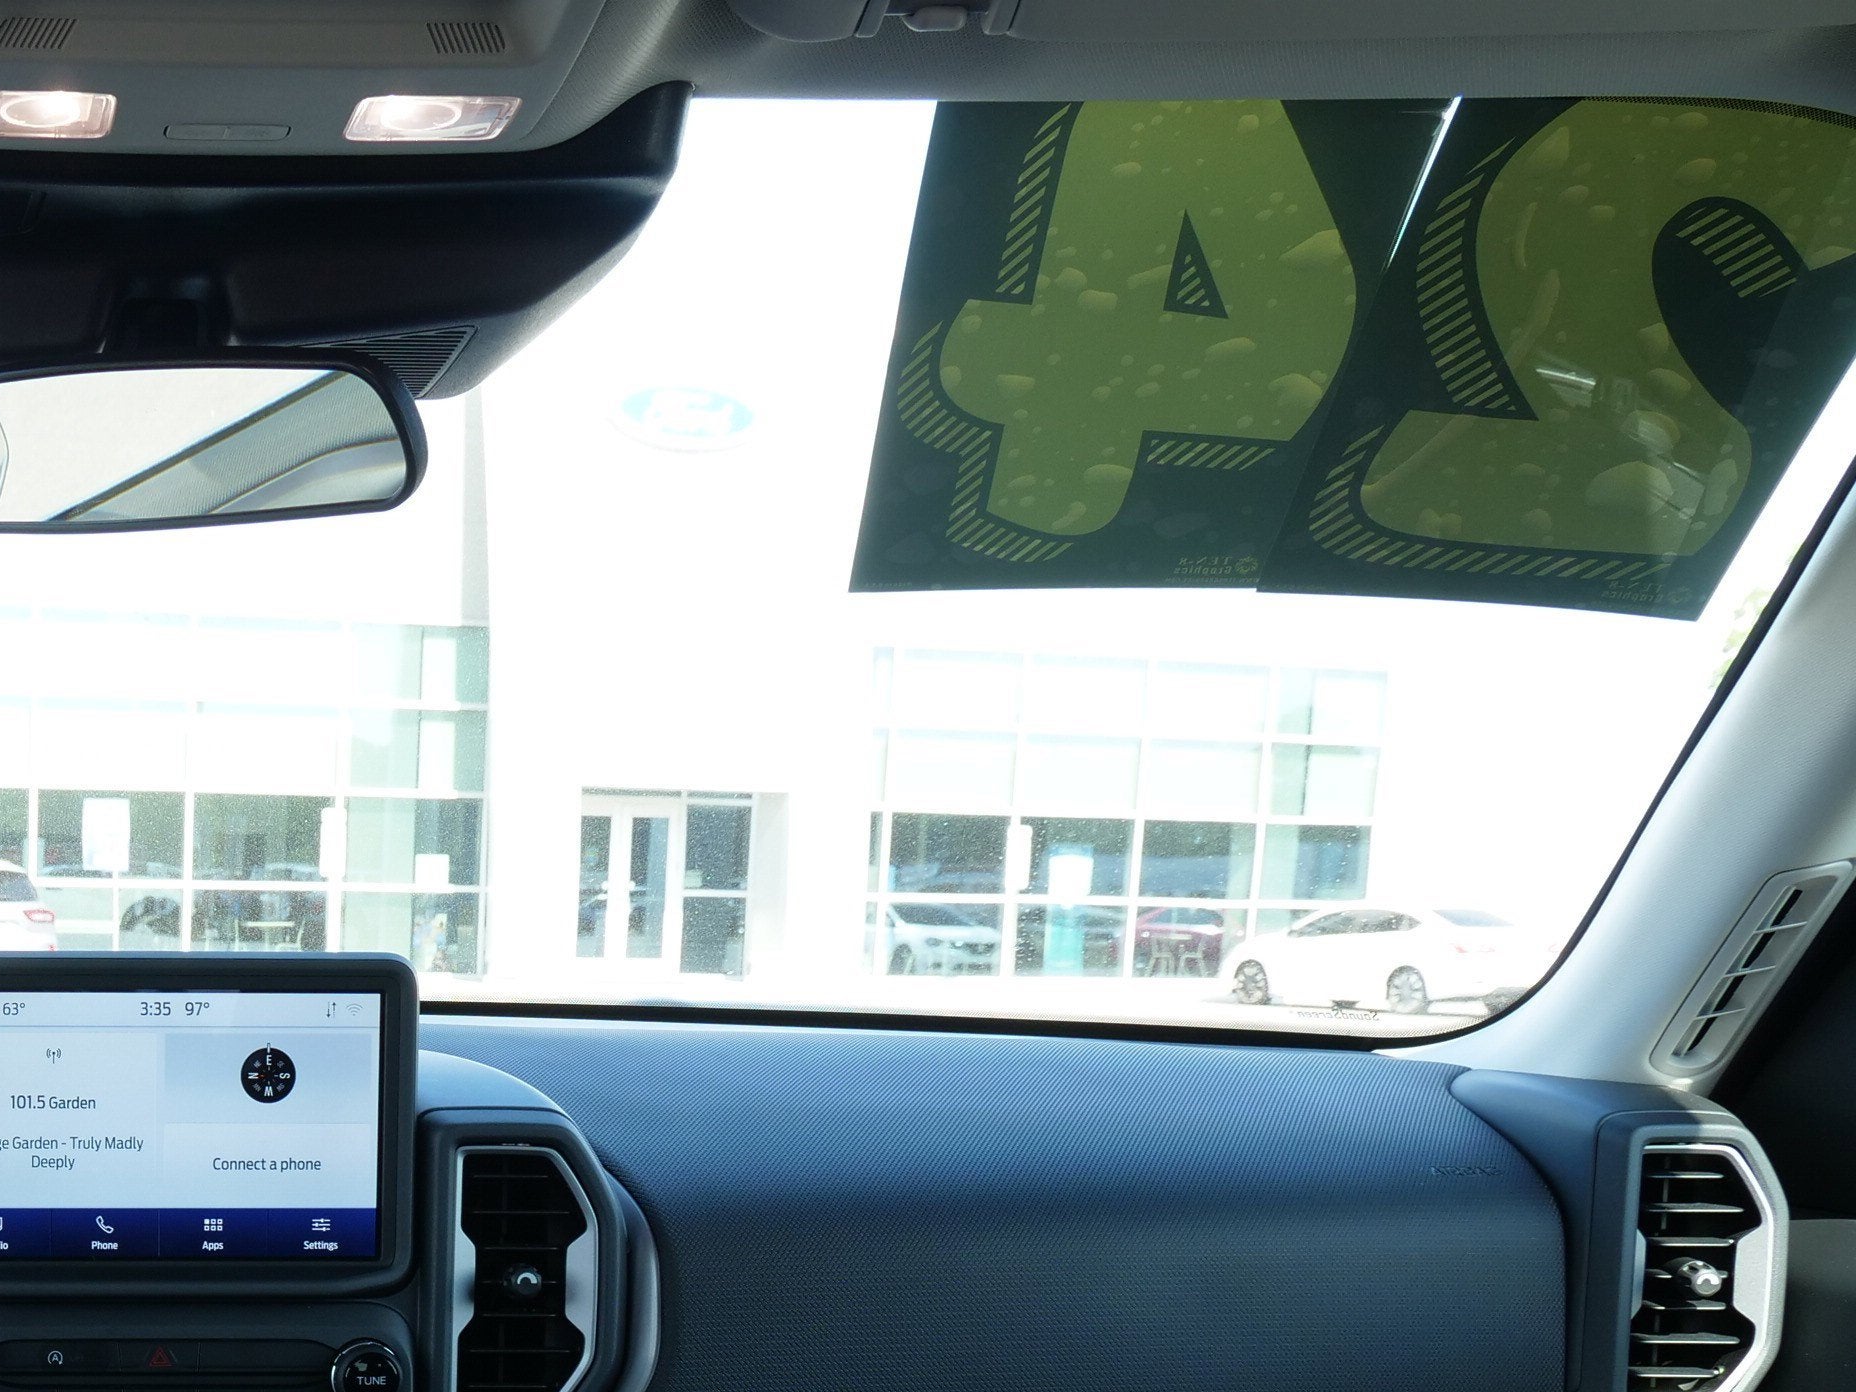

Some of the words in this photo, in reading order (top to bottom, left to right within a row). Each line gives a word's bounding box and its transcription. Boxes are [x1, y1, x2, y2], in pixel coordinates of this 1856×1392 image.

[2, 1002, 26, 1016] 63°
[140, 1002, 171, 1016] 3:35
[184, 1002, 210, 1016] 97°
[266, 1054, 272, 1066] E
[264, 1086, 273, 1097] W
[10, 1095, 46, 1109] 101.5
[49, 1096, 96, 1110] Garden
[12, 1136, 58, 1150] Garden
[70, 1136, 102, 1152] Truly
[104, 1136, 144, 1152] Madly
[31, 1155, 75, 1170] Deeply
[212, 1157, 266, 1171] Connect
[269, 1160, 278, 1171] a
[280, 1157, 322, 1173] phone
[90, 1240, 119, 1250] Phone
[201, 1240, 225, 1253] Apps
[303, 1240, 339, 1253] Settings
[356, 1376, 387, 1385] TUNE
